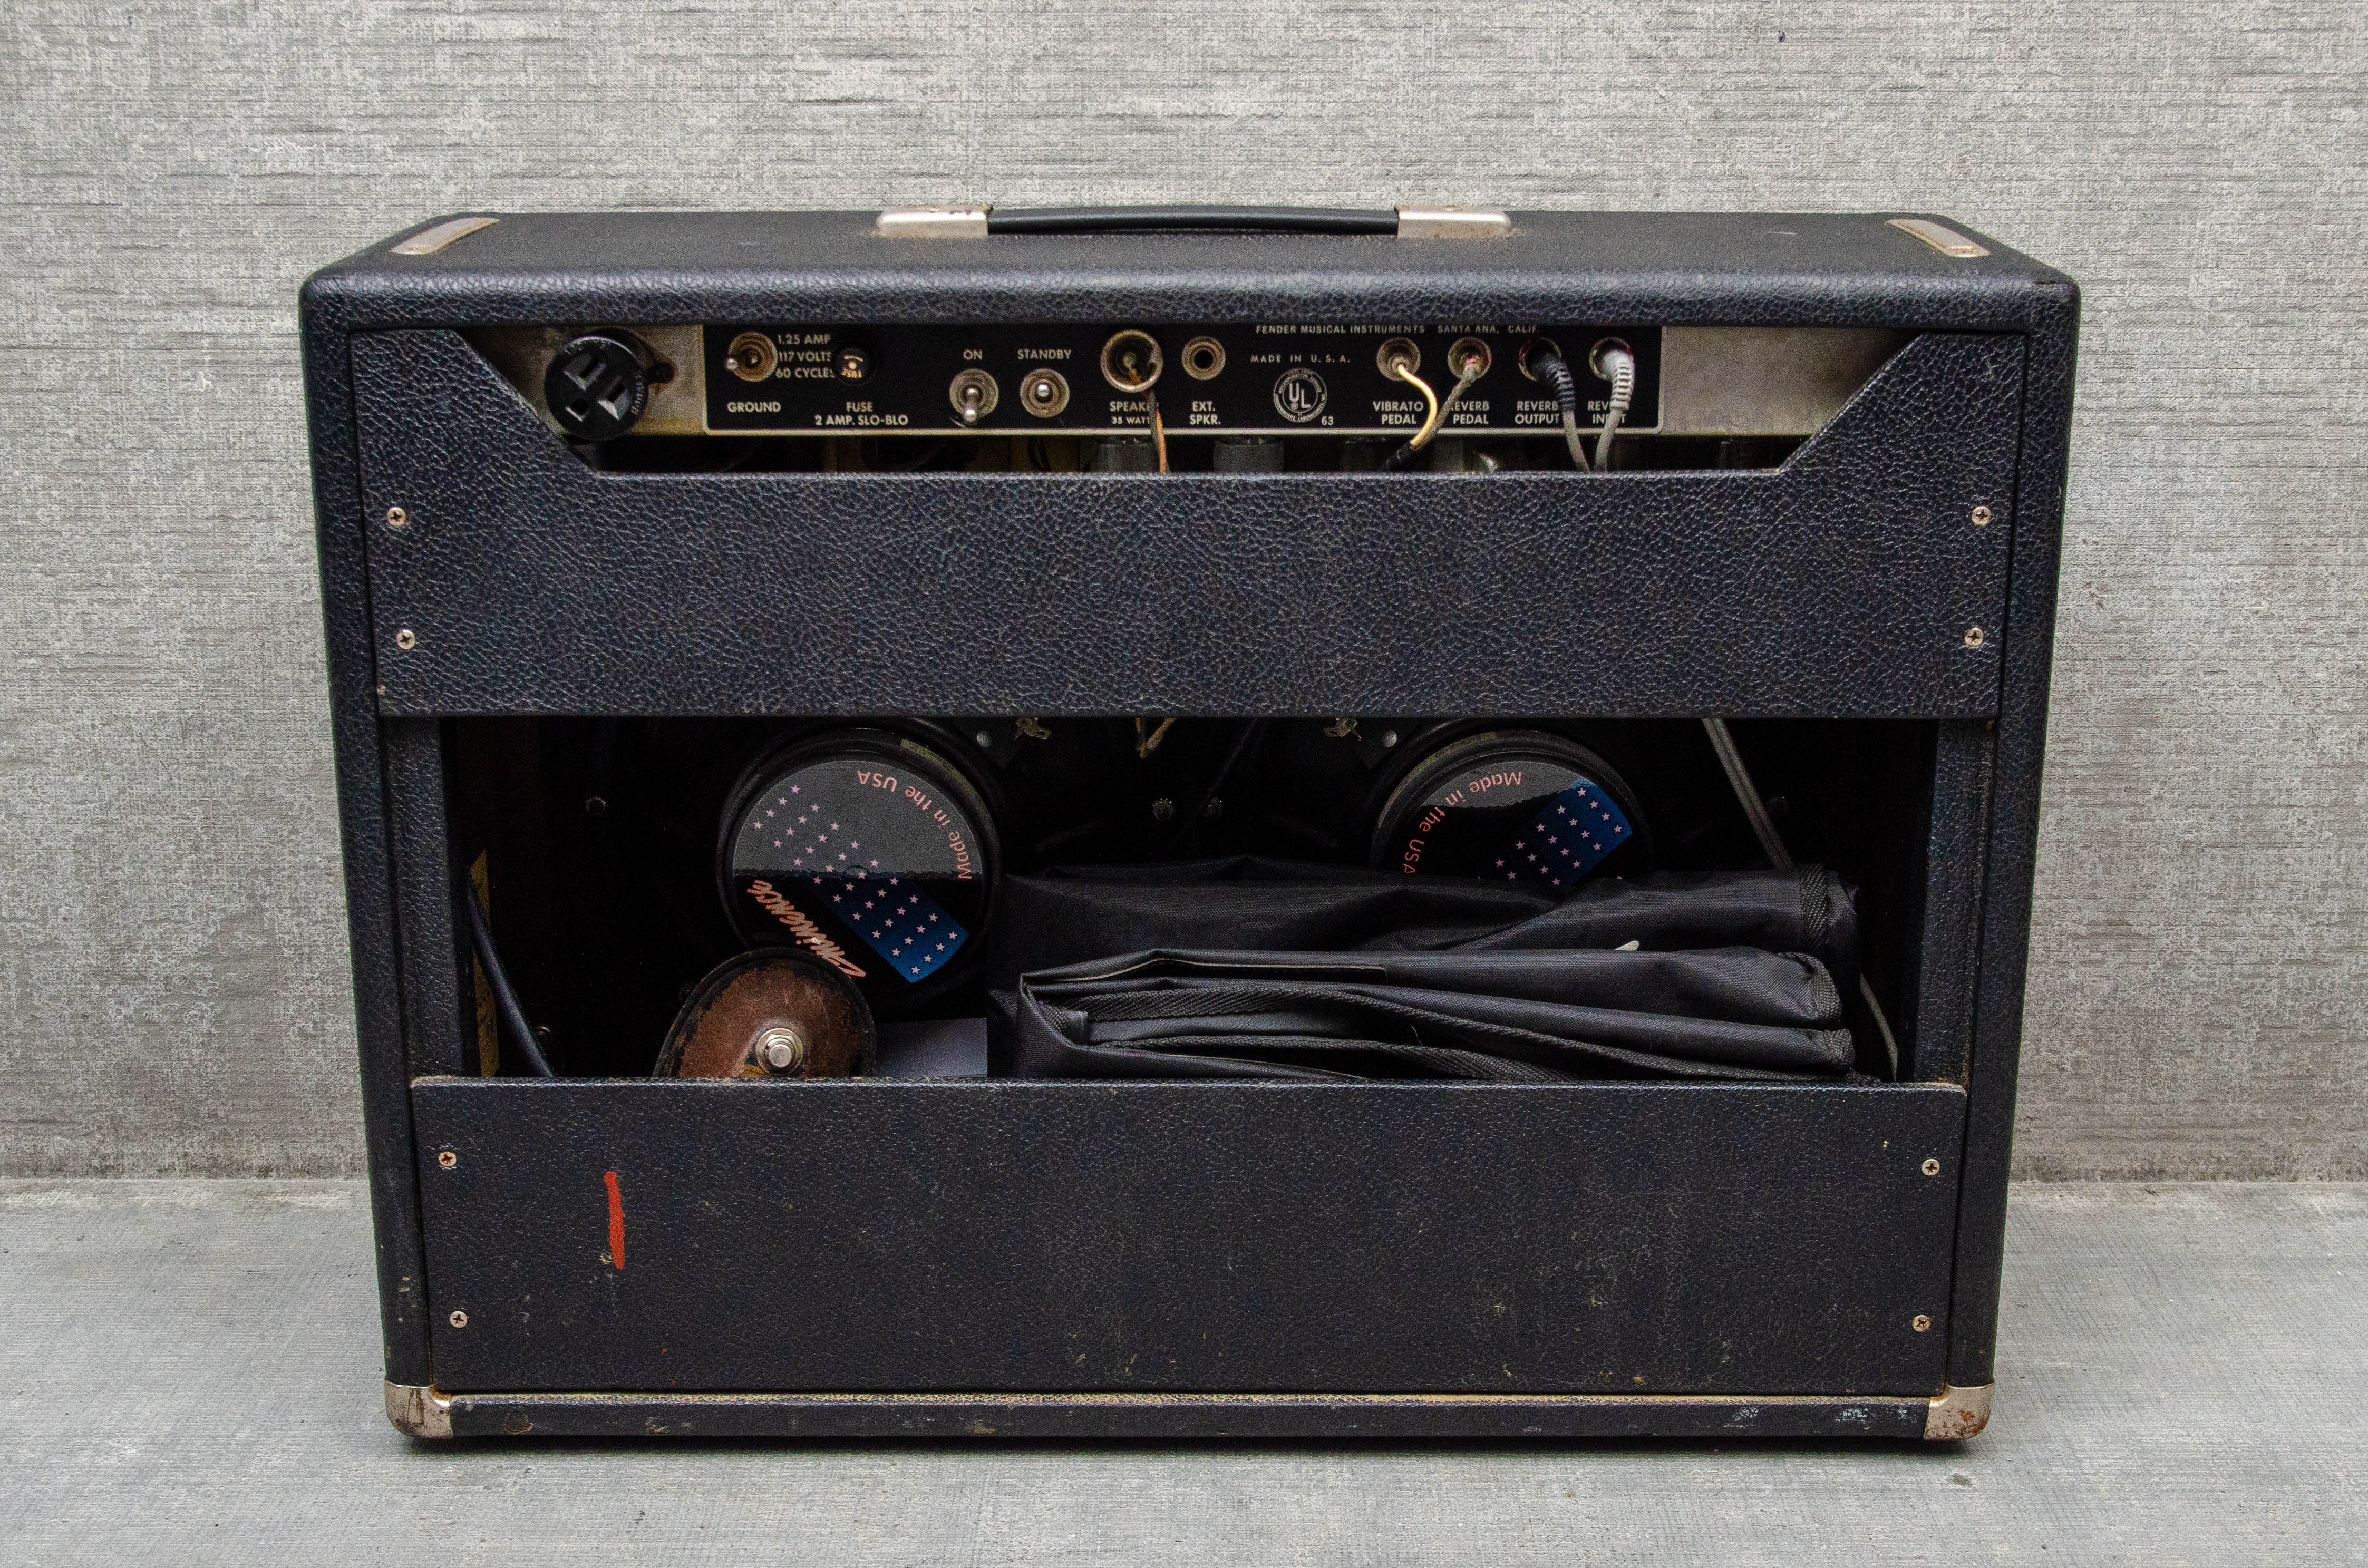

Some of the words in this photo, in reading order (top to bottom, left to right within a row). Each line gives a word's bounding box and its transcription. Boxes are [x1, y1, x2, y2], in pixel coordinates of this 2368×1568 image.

[1256, 325, 1297, 334] FENDER
[1301, 325, 1346, 334] MUSICAL
[1350, 325, 1424, 334] INSTRUMENTS
[1438, 325, 1471, 334] SANTA
[778, 334, 800, 345] 1.25
[804, 334, 831, 345] AMP
[778, 350, 794, 362] 117
[963, 349, 983, 361] ON
[1017, 348, 1072, 360] STANDBY
[1251, 354, 1282, 363] MADE
[1290, 354, 1302, 363] IN
[775, 367, 791, 378] 60
[1289, 382, 1312, 409] UL
[727, 401, 781, 413] GROUND
[846, 401, 873, 412] FUSE
[1192, 401, 1215, 412] EXT.
[1373, 401, 1423, 412] VIBRATO
[1451, 401, 1489, 412] EVERB
[1517, 400, 1559, 411] REVERB
[814, 415, 822, 426] 2
[826, 415, 856, 426] AMP.
[858, 415, 909, 426] SLO-BLO
[1189, 414, 1221, 425] SPKR.
[1322, 415, 1333, 425] 63
[1381, 414, 1416, 425] PEDAL
[1453, 414, 1489, 425] PEDAL
[1515, 413, 1559, 425] OUTPUT
[1592, 413, 1626, 425] INT
[857, 770, 898, 792] USA
[1469, 771, 1522, 794] Made
[905, 785, 933, 811] the
[1445, 789, 1468, 807] in
[933, 808, 952, 829] in
[1419, 805, 1447, 832] the
[948, 831, 973, 880] Made
[1403, 839, 1425, 874] USA
